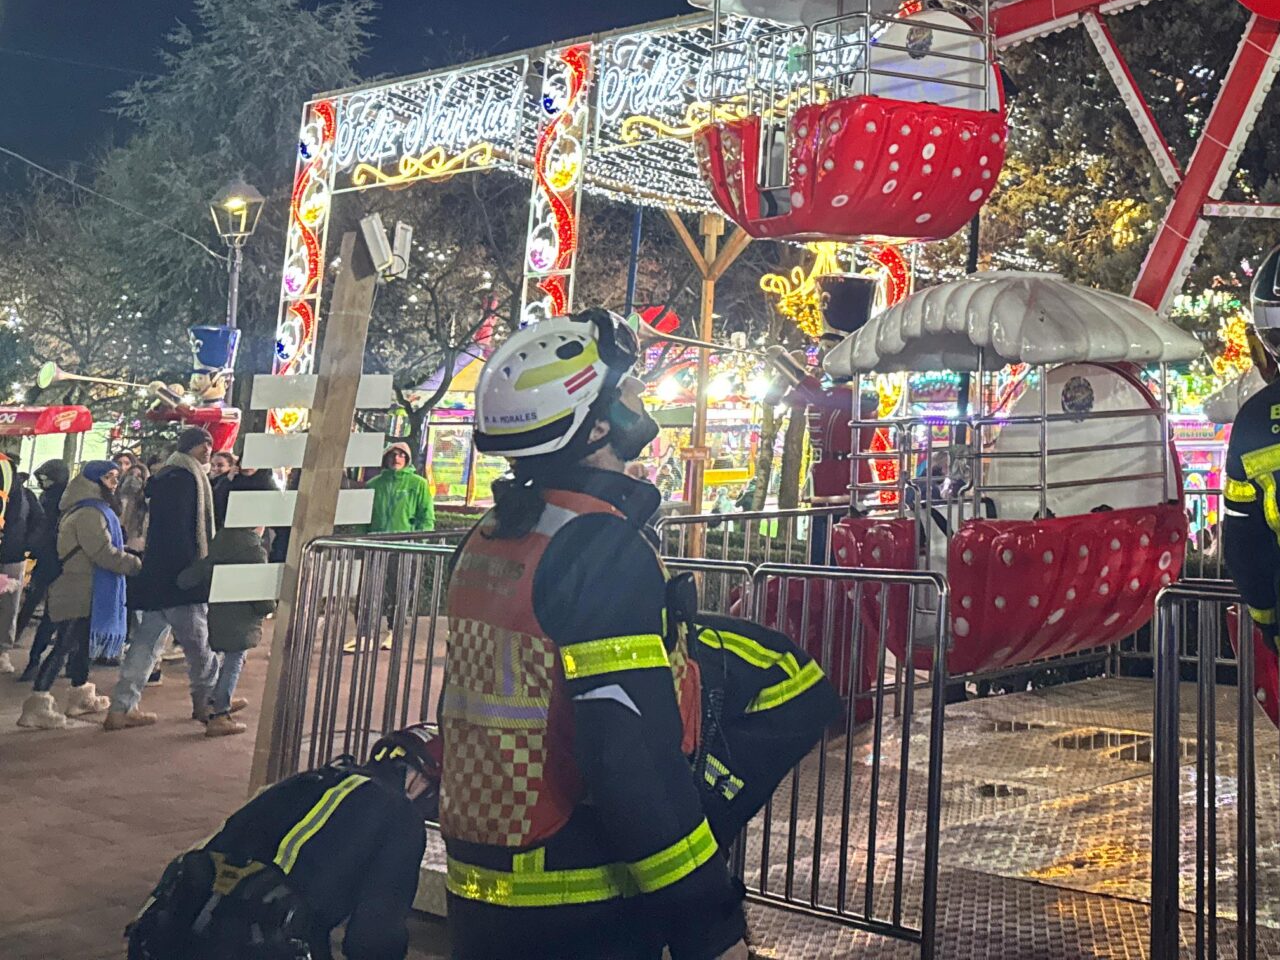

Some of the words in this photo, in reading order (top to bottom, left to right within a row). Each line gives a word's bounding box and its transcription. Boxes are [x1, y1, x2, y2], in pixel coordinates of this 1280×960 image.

[336, 93, 398, 165] Feliz
[401, 73, 524, 157] Navidad
[600, 34, 689, 121] Feliz
[500, 411, 538, 424] MORALES
